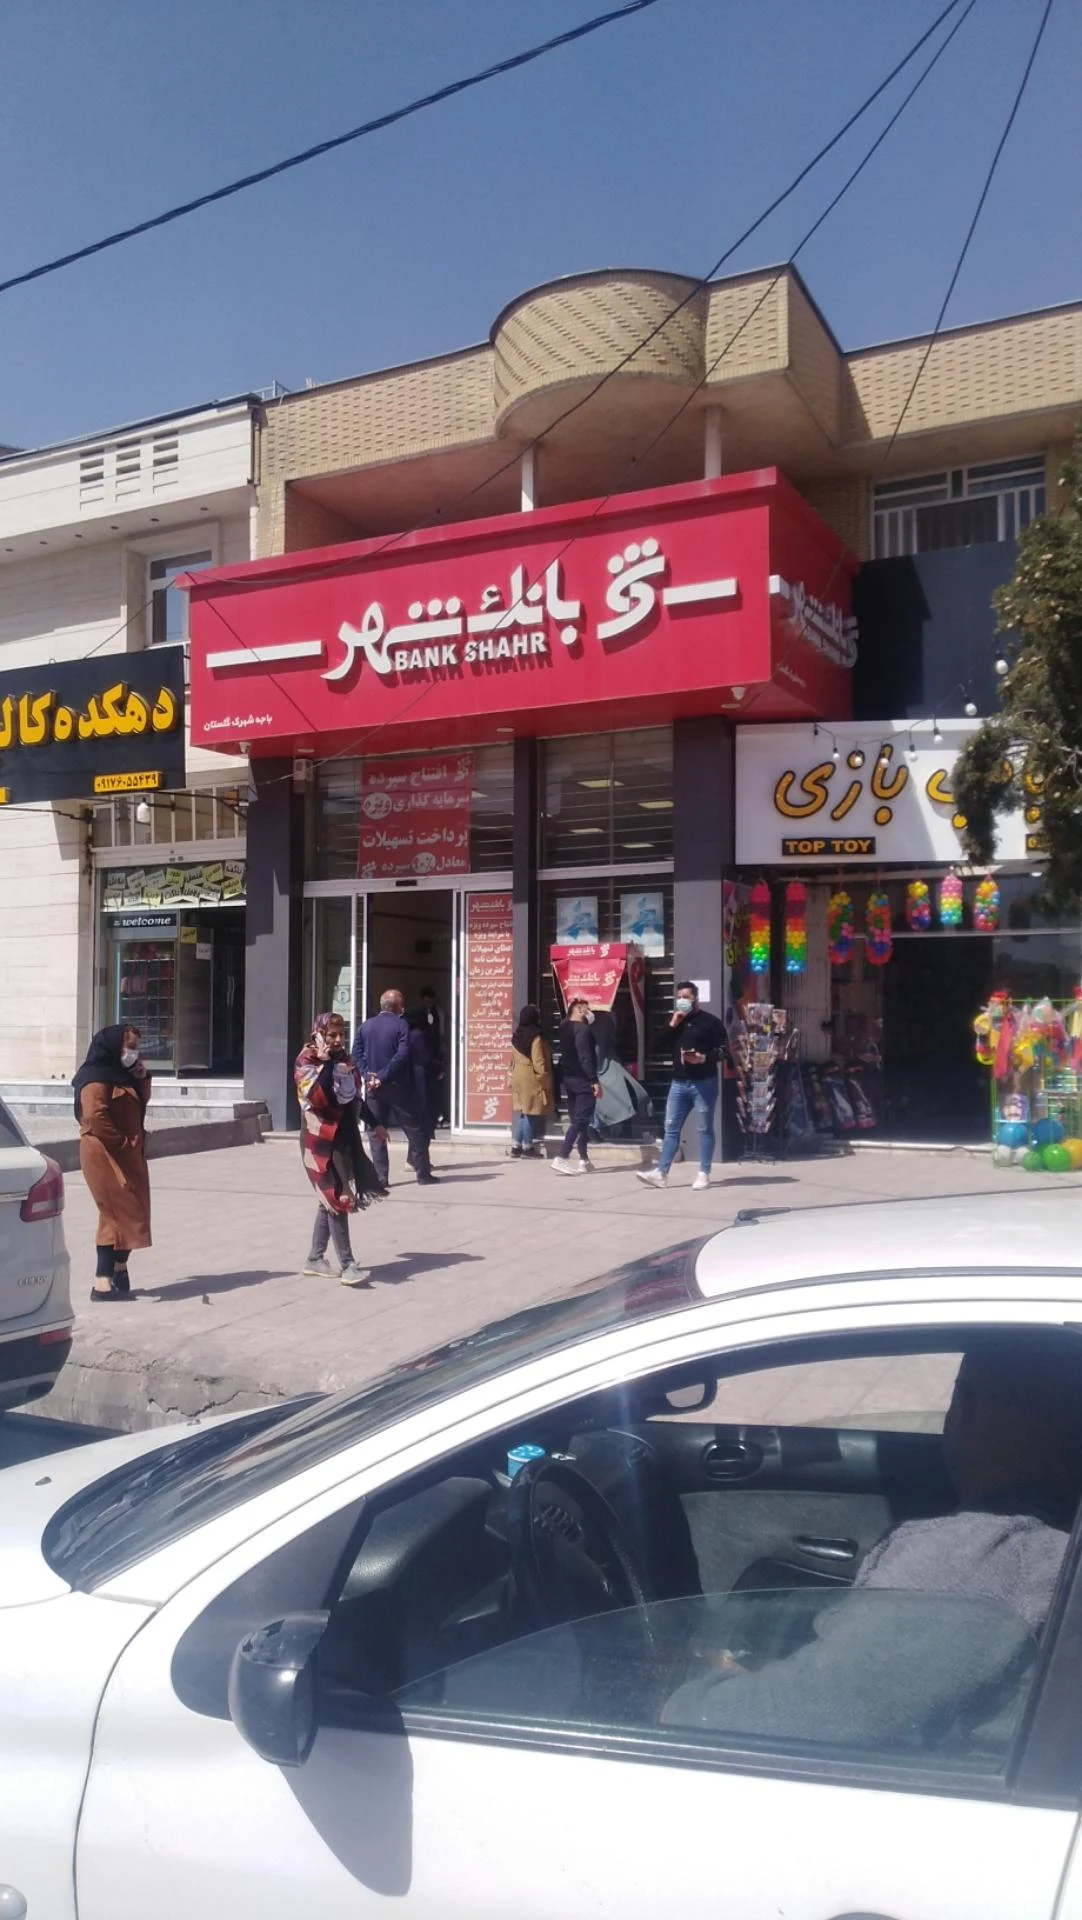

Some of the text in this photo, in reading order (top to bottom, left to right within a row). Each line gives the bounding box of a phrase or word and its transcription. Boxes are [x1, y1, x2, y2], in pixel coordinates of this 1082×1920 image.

[320, 597, 462, 681] شهر
[395, 631, 548, 671] BANK SHAHR
[54, 681, 176, 743] دهکده
[203, 713, 273, 732] باجه شهرک گلستان
[369, 764, 447, 790] افتتاح سپرده
[774, 744, 908, 826] بازی
[362, 827, 468, 850] پرداخت تسهیلات
[786, 839, 872, 853] TOP TOY
[436, 856, 466, 871] معادل
[122, 917, 171, 927] welcome
